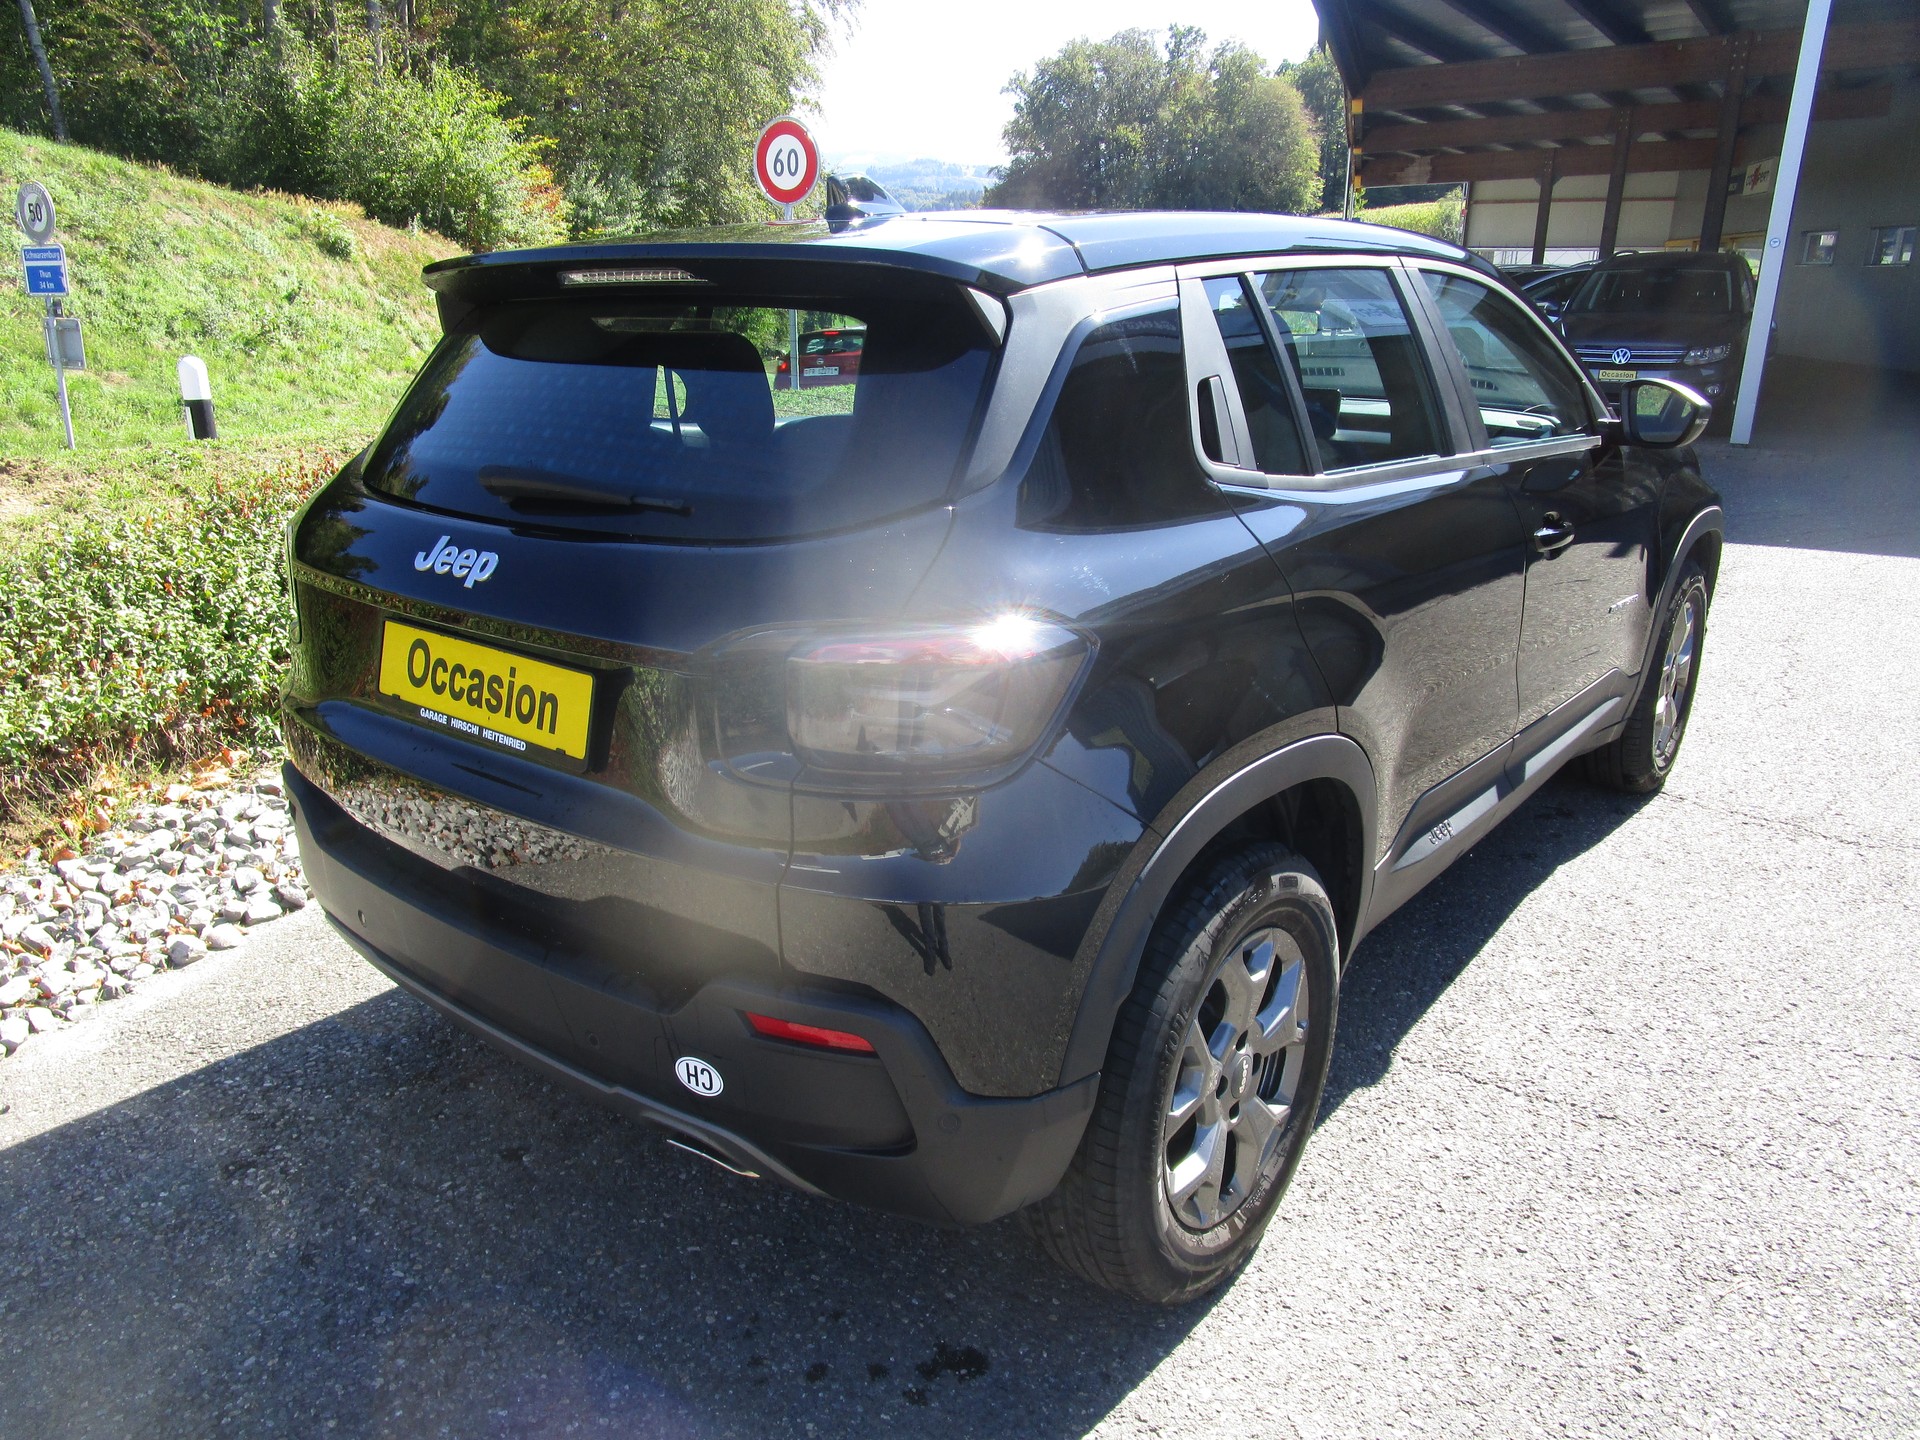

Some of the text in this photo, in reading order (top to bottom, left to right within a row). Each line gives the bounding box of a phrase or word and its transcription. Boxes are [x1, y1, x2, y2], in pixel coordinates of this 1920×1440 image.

[773, 148, 799, 177] 60
[28, 203, 43, 222] 50
[25, 250, 60, 261] Schwarzenburg
[39, 270, 52, 278] Thun
[39, 281, 55, 289] 34 km
[1601, 371, 1634, 379] Occasion
[414, 535, 499, 589] Jeep
[407, 638, 559, 735] Occasion
[420, 707, 527, 751] GARAGE HIRSCHI HEITENRIED
[1428, 819, 1454, 846] Jeep
[686, 1062, 713, 1091] CH
[1239, 1060, 1249, 1094] Jeep
